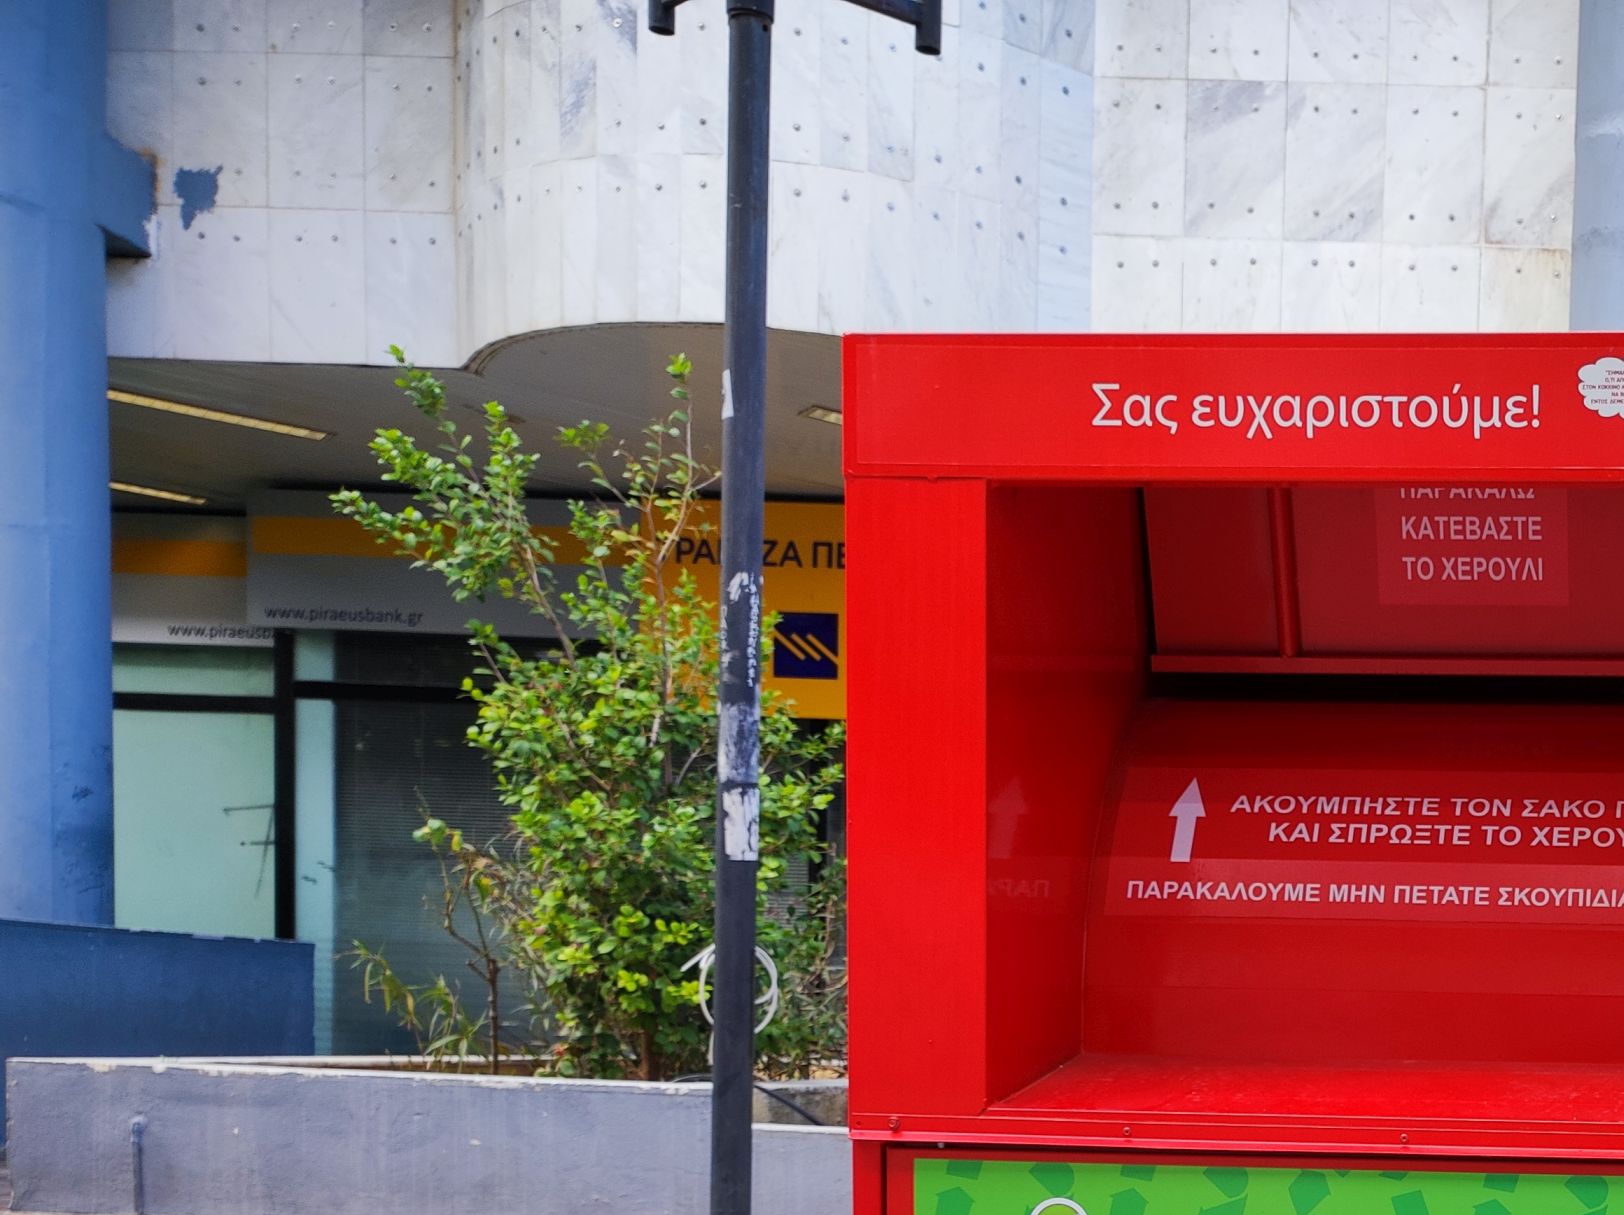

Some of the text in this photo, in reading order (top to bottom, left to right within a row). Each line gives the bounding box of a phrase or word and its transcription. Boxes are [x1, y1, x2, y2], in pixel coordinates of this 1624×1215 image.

[1091, 383, 1541, 440] Σας ευχαριστούμε!
[1401, 516, 1543, 541] ΚΑΤΕΒΑΣΤΕ
[1402, 556, 1543, 581] ΤΟ ΧΕΡΟΥΛΙ
[264, 606, 423, 627] www.piraeusbank.gr
[1230, 795, 1441, 817] ΑΚΟΥΜΠΗΣΤΕ
[1450, 798, 1512, 818] ΤΟΝ
[1521, 798, 1606, 819] ΣΑΚΟ
[1268, 822, 1321, 843] ΚΑΙ
[1328, 823, 1471, 846] ΣΠΡΩΞΤΕ
[1481, 825, 1522, 846] ΤΟ
[1126, 880, 1321, 903] ΠΑΡΑΚΑΛΟΥΜΕ
[1328, 884, 1386, 904] ΜΗΝ
[1393, 885, 1490, 906] ΠΕΤΑΤΕ
